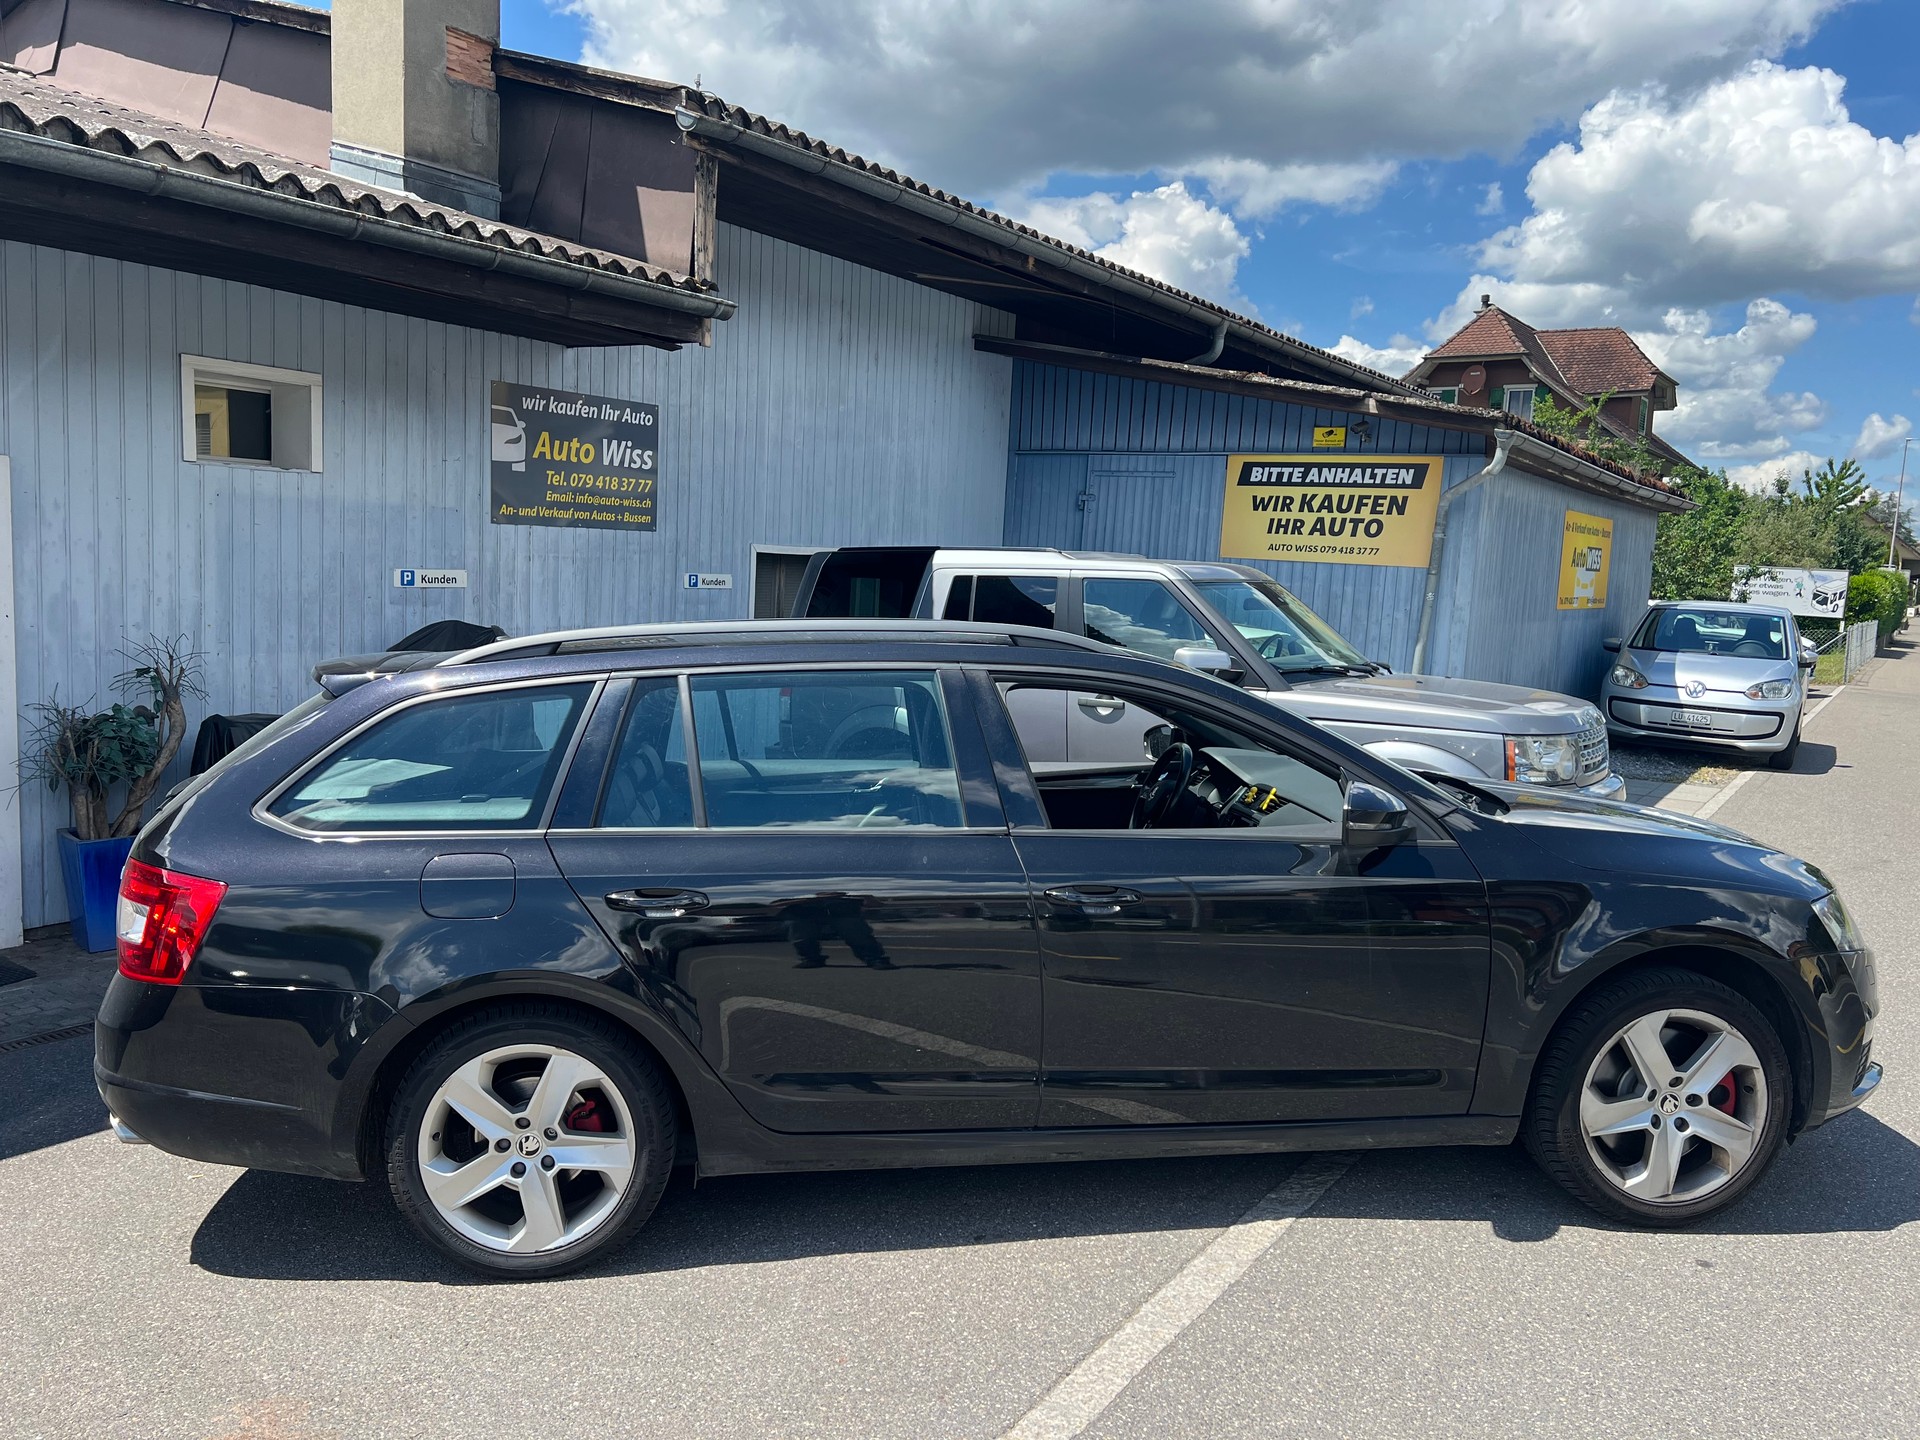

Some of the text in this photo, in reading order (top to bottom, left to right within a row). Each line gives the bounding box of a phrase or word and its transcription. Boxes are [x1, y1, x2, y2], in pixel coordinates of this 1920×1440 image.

[522, 395, 653, 426] wir kaufen Ihr Auto
[533, 431, 653, 470] Auto Wiss
[546, 471, 652, 493] Tel. 079 418 37 77
[1250, 467, 1415, 485] BITTE ANHALTEN
[546, 491, 652, 508] Email: info@auto-wiss.ch
[1251, 493, 1409, 516] WIR KAUFEN
[500, 504, 517, 515] An-
[519, 506, 537, 516] und
[539, 506, 574, 519] Verkauf
[574, 511, 589, 520] von
[591, 510, 615, 521] Autos
[624, 512, 651, 523] Bussen
[1267, 516, 1384, 538] IHR AUTO
[1267, 543, 1380, 556] AUTO WISS 079 418 37 77
[1571, 547, 1602, 570] Auto WISS
[421, 574, 457, 584] Kunden
[701, 578, 726, 586] Kunden
[1673, 712, 1709, 723] LU 41425
